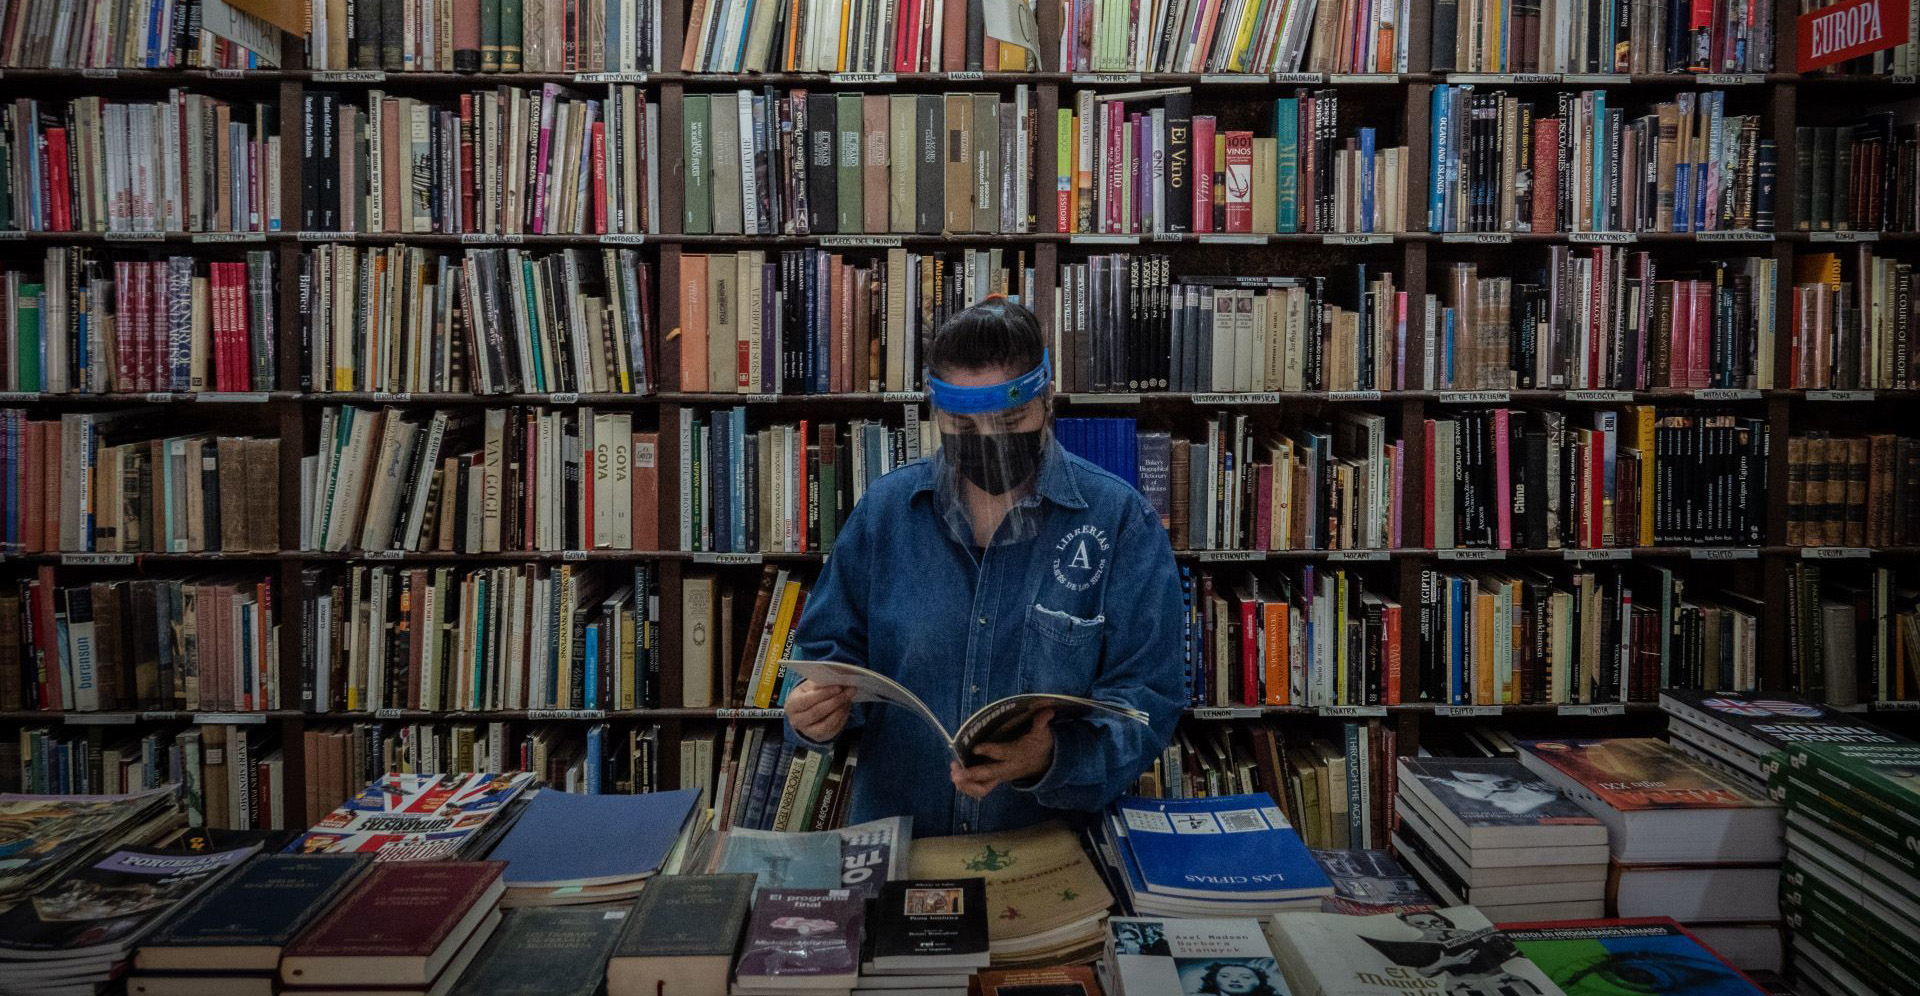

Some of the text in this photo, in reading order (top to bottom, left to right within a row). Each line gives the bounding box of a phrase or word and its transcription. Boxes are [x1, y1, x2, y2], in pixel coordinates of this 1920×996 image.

[1811, 1, 1882, 58] EUROPA
[1096, 74, 1127, 82] POSTRES
[1226, 138, 1251, 147] 1001
[1316, 130, 1322, 140] LA
[1324, 128, 1329, 138] LA
[1557, 96, 1566, 171] LOST DISCOVERIES
[742, 138, 752, 174] LOUVRE
[1171, 126, 1186, 188] El Vino
[1437, 117, 1448, 194] OCEANS AND ISLANDS
[1609, 114, 1618, 207] IN SEARCH OF LOST WORLDS
[1196, 174, 1209, 203] Vino
[854, 237, 869, 245] DEL
[872, 237, 899, 245] MUNDO
[1157, 233, 1180, 241] VINOS
[935, 260, 944, 306] Museums
[1832, 259, 1841, 292] Rome
[179, 269, 190, 345] DICTIONARY
[1153, 310, 1158, 318] 2
[1593, 281, 1601, 326] MYTHOLOGY
[752, 287, 760, 386] MUSEOS DE FLORENCIA
[1660, 295, 1670, 368] THE GREEK MYTHS
[1897, 276, 1908, 378] THE COURTS OF EUROPE
[1604, 416, 1615, 432] TIBET
[484, 439, 499, 519] VAN GOGH
[597, 444, 608, 480] GOYA
[615, 445, 626, 481] GOYA
[1139, 465, 1169, 474] Biographical
[1142, 473, 1168, 481] Dictionary
[1514, 484, 1525, 513] Chine
[1068, 539, 1092, 569] A
[552, 572, 560, 613] LEONARDO
[1421, 570, 1430, 604] EGIPTO
[560, 569, 569, 659] LEONARDO'S INVENTIONS
[74, 637, 92, 689] berenson
[1389, 644, 1400, 677] BRAVO
[1590, 706, 1607, 714] INDIA
[238, 740, 247, 810] EXPRESIONISMO
[1349, 736, 1358, 782] THROUGH
[250, 758, 258, 821] MODERN PAINTING
[782, 769, 800, 810] MODERN
[357, 818, 454, 831] GUITARRISTAS
[1352, 804, 1360, 826] AGES
[1184, 873, 1284, 884] LAS CIFRAS
[794, 900, 821, 908] final
[1356, 972, 1438, 989] Mundo
[1385, 967, 1409, 979] El
